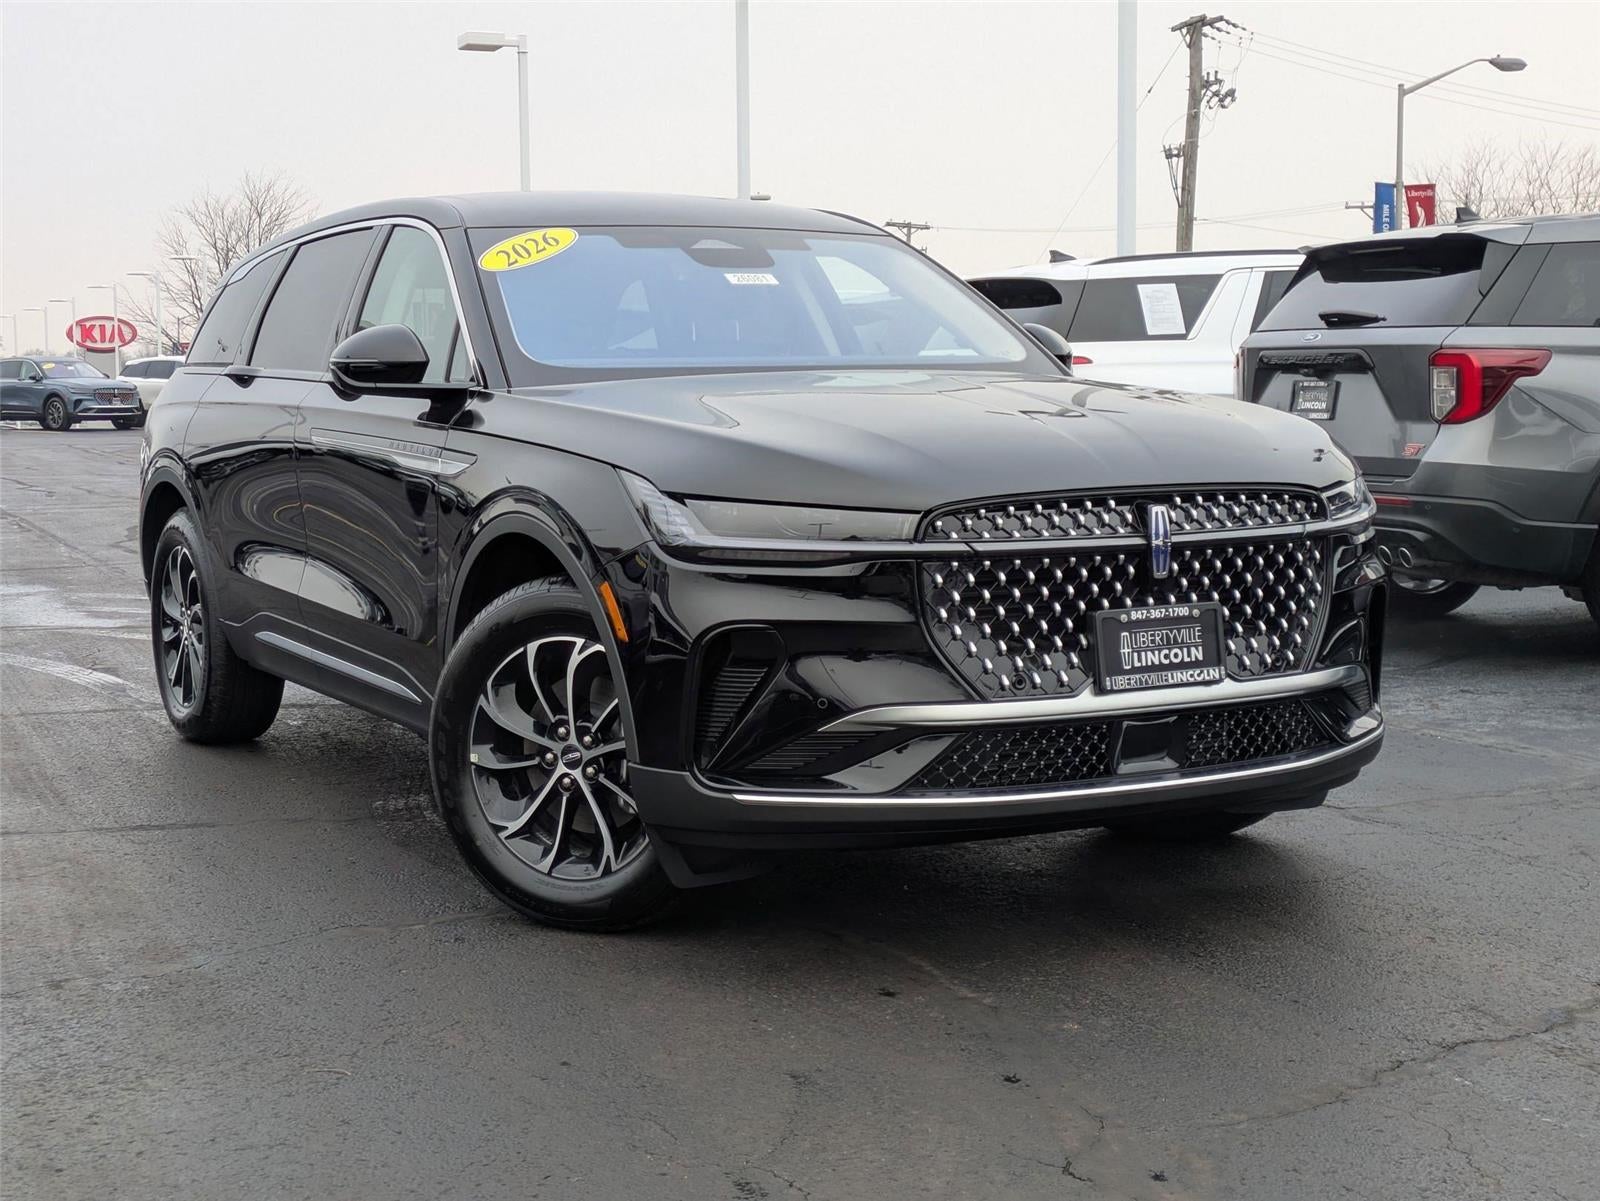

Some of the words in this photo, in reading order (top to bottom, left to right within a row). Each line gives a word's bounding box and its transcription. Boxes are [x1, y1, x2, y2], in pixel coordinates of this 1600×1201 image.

[1382, 204, 1390, 223] MILE
[496, 231, 560, 267] 2026
[81, 324, 126, 342] KIA
[1268, 355, 1345, 364] EXPLORER
[1300, 401, 1327, 410] LINCOLN
[1131, 607, 1189, 620] 847-367-1700
[1132, 627, 1202, 648] LIBERTYVILLE
[1133, 646, 1204, 667] LINCOLN
